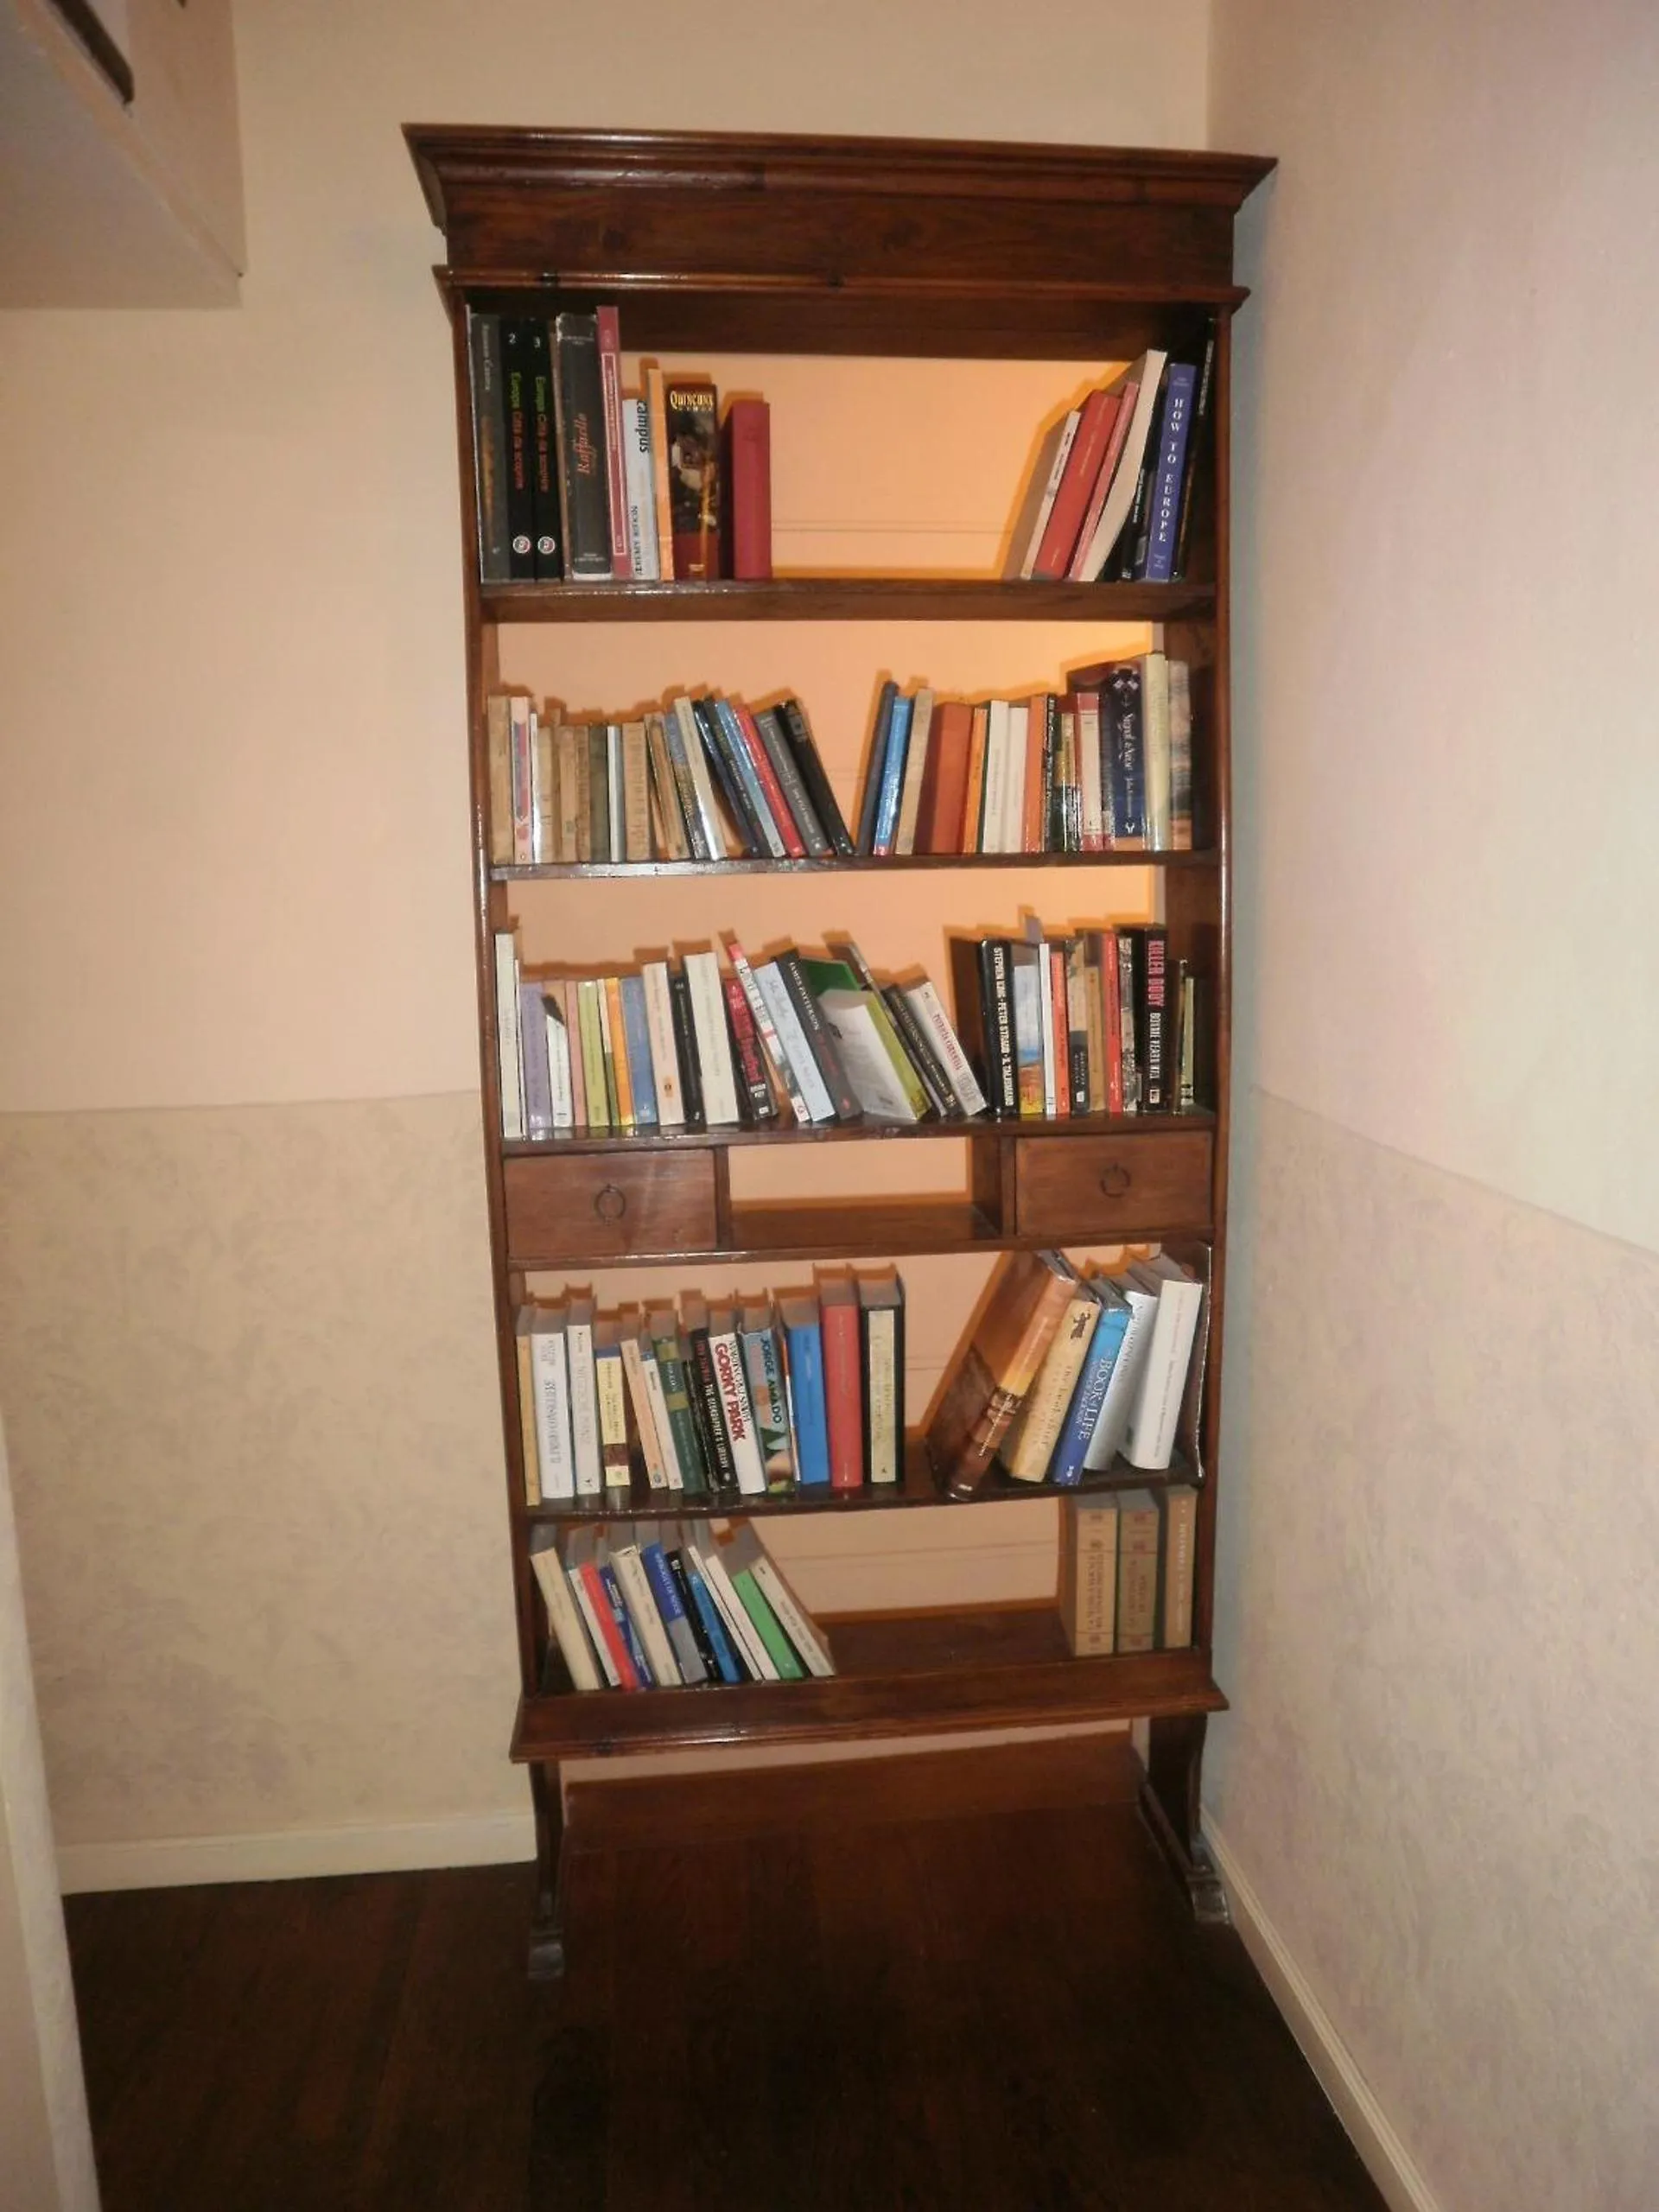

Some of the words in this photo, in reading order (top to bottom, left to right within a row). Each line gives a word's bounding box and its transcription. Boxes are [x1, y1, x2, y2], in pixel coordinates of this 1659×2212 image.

[637, 400, 648, 454] campus
[1170, 398, 1184, 432] HOW
[1166, 442, 1177, 464] TO
[1159, 474, 1173, 543] EUROPE
[994, 947, 1004, 979] STEPHEN
[1147, 940, 1165, 975] KILLER
[996, 981, 1007, 998] KING
[1147, 978, 1165, 1006] BODY
[998, 1001, 1008, 1024] PETER
[760, 1338, 775, 1376] JORGE
[715, 1343, 737, 1398] GORKY
[727, 1399, 747, 1442] PARK
[1092, 1357, 1113, 1402] BOOK
[767, 1379, 782, 1424] AMADO
[1078, 1405, 1099, 1441] LIFE
